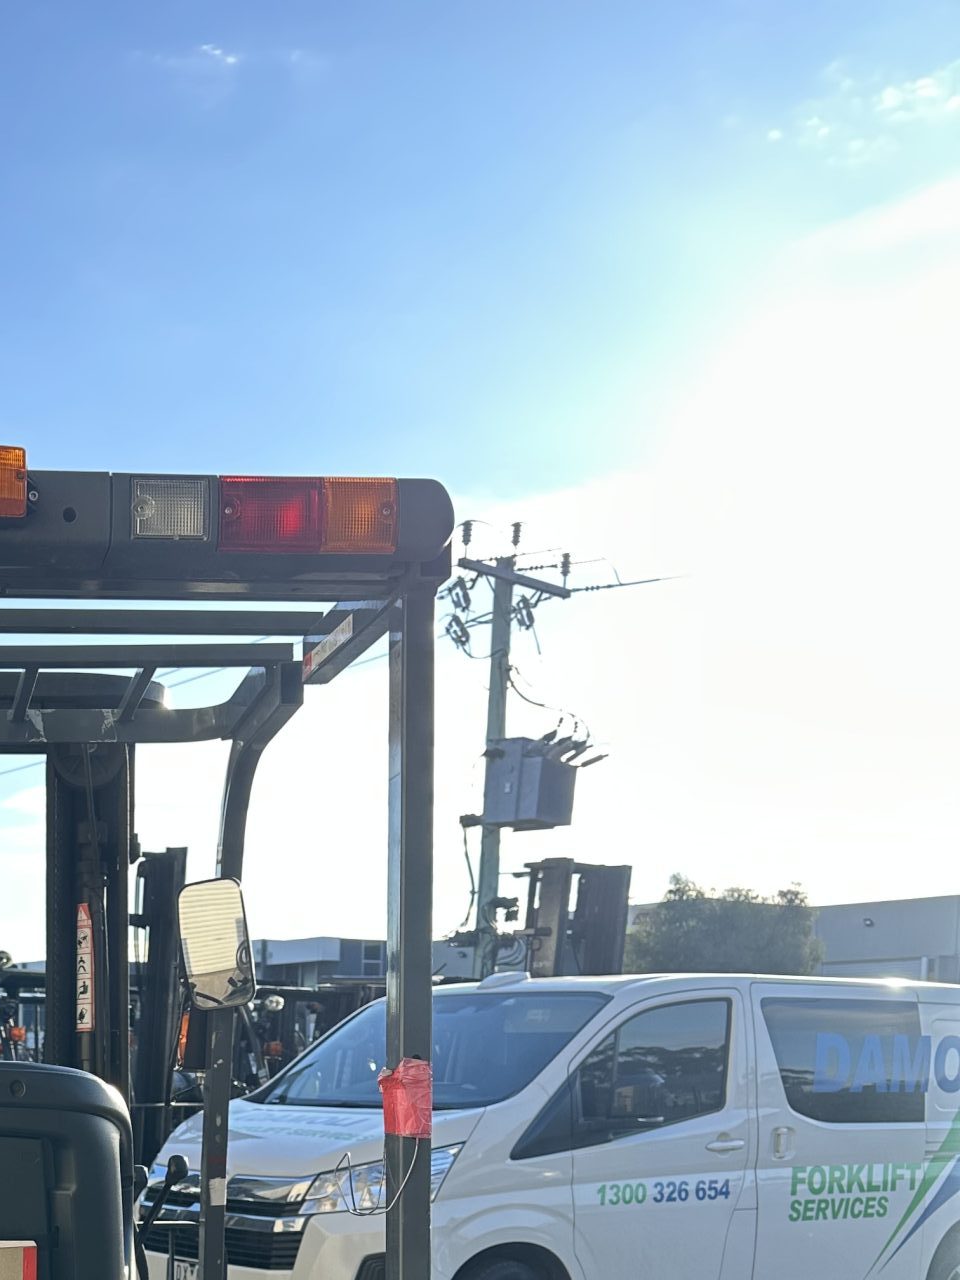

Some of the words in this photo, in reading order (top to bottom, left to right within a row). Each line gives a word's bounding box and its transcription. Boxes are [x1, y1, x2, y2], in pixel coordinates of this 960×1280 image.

[811, 1030, 960, 1094] DAMO
[596, 1182, 647, 1207] 1300
[652, 1180, 689, 1204] 326
[694, 1178, 731, 1202] 654
[789, 1162, 922, 1196] FORKLIFT
[788, 1195, 889, 1222] SERVICES
